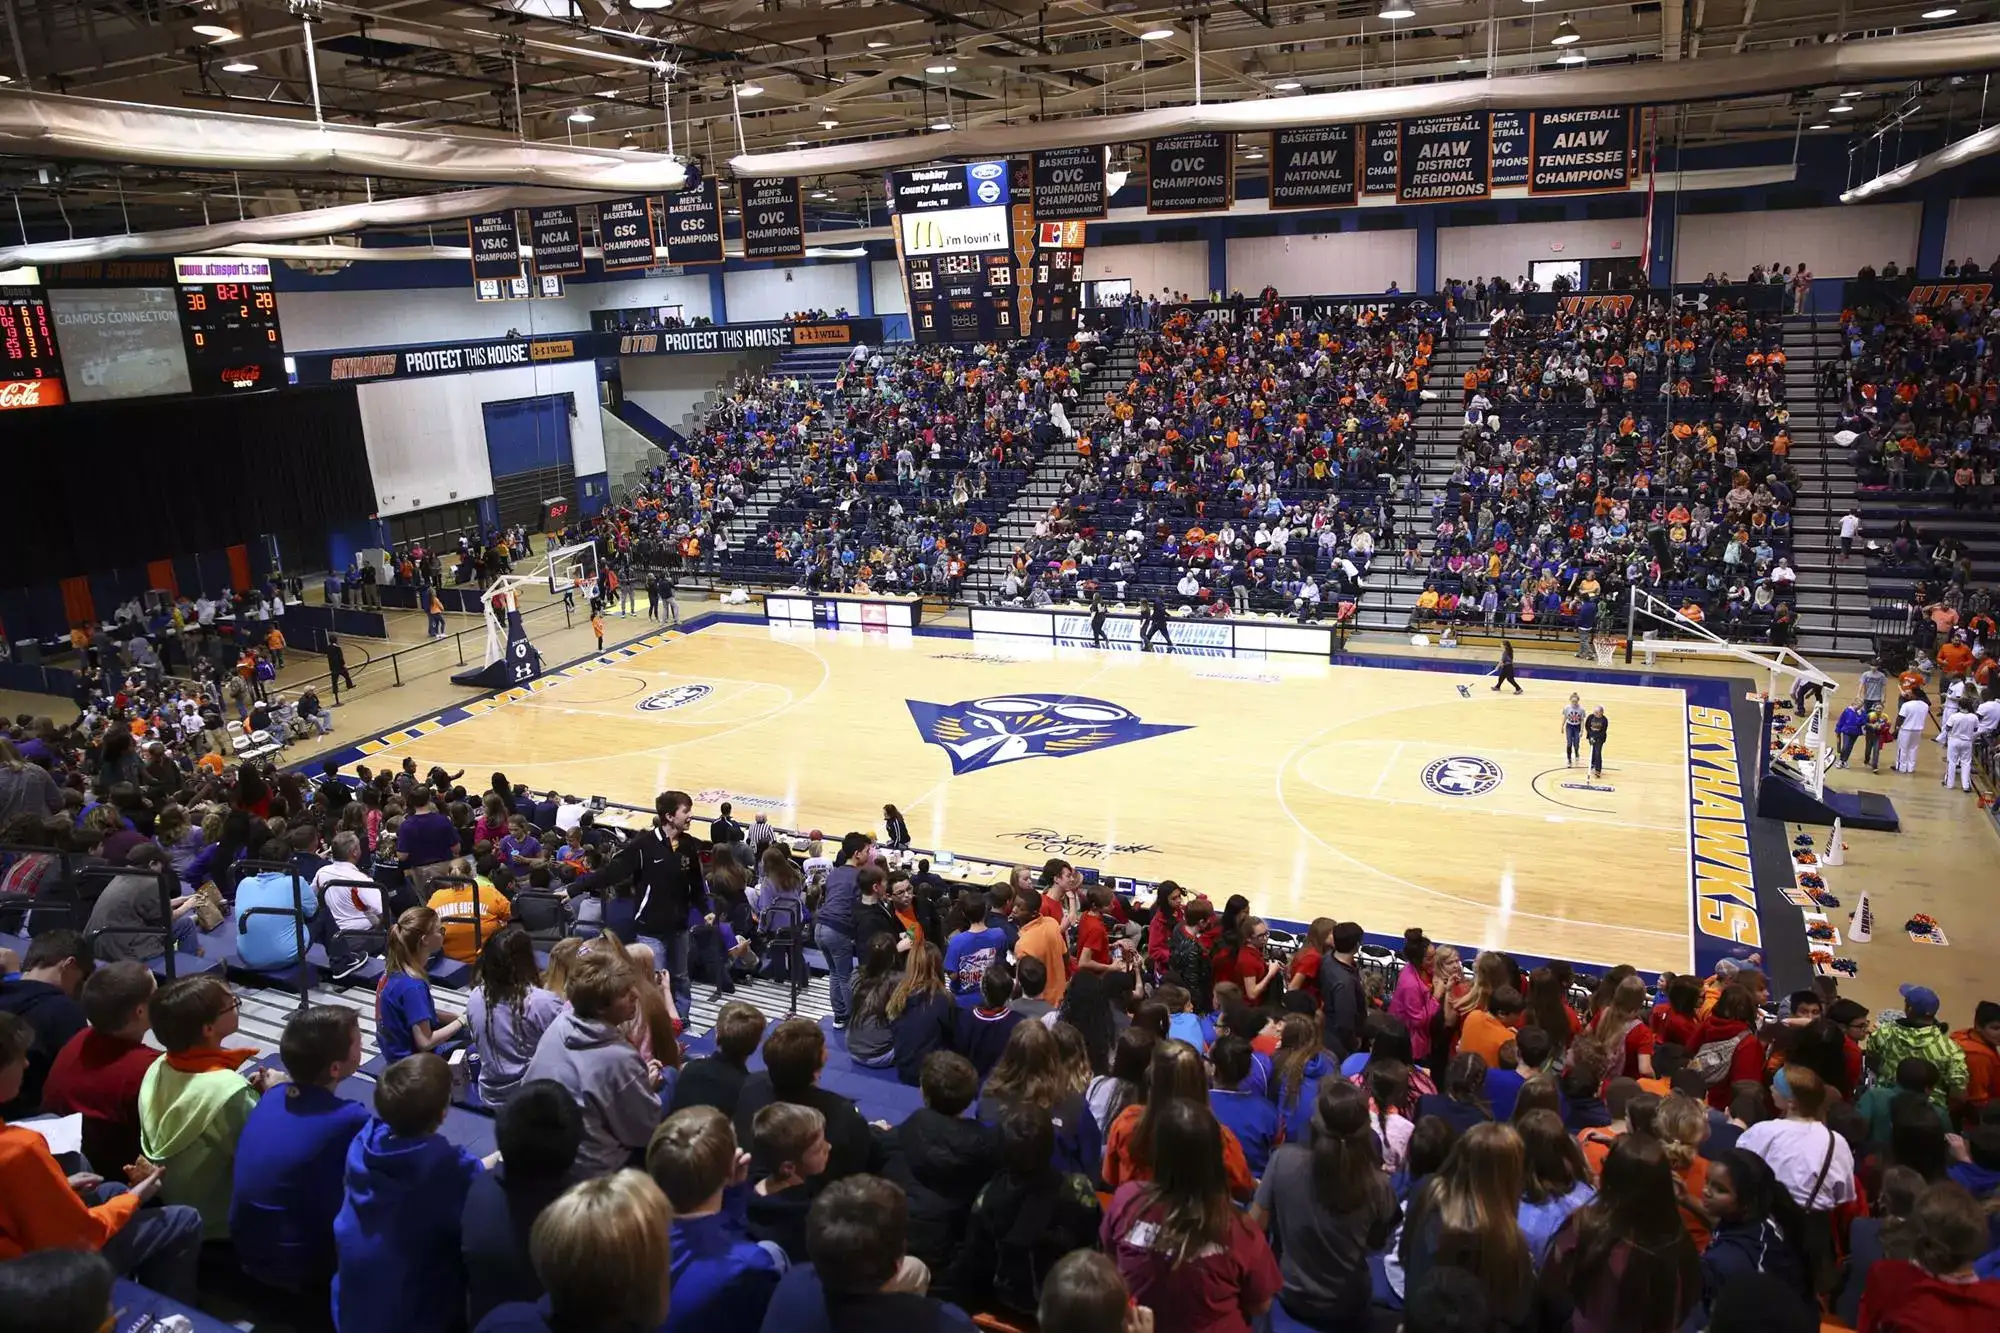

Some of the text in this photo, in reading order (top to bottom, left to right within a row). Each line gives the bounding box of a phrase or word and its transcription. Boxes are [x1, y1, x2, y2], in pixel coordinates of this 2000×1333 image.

[1542, 108, 1621, 125] BASKETBALL
[1408, 120, 1481, 136] BASKETBALL
[1280, 130, 1348, 144] BASKETBALL
[1552, 129, 1610, 149] AIAW
[1156, 138, 1219, 151] BASKETBALL
[1418, 140, 1471, 158] AIAW
[1039, 155, 1097, 168] BASKETBALL
[1289, 150, 1338, 167] AIAW
[1416, 157, 1473, 171] DISTRICT
[1539, 150, 1623, 167] TENNESSEE
[1170, 157, 1206, 173] OVC
[912, 170, 948, 181] Weakley
[1052, 168, 1084, 184] OVC
[1284, 169, 1342, 182] NATIONAL
[1412, 171, 1475, 184] REGIONAL
[1535, 167, 1624, 185] CHAMPIONS
[1152, 175, 1224, 189] CHAMPIONS
[758, 188, 781, 198] MEN'S
[900, 185, 930, 195] County
[1035, 181, 1102, 196] TOURNAMENT
[1274, 183, 1353, 197] TOURNAMENT
[1403, 183, 1485, 198] CHAMPIONS
[679, 195, 702, 205] MEN'S
[747, 195, 793, 207] BASKETBALL
[1039, 193, 1099, 206] CHAMPIONS
[1165, 197, 1196, 206] SECOND
[1197, 196, 1225, 205] ROUND
[612, 202, 633, 212] MEN'S
[669, 202, 713, 214] BASKETBALL
[1036, 205, 1103, 217] NCAA TOURNAMENT
[542, 210, 563, 219] MEN'S
[603, 209, 643, 220] BASKETBALL
[759, 211, 785, 225] OVC
[482, 217, 502, 225] MEN'S
[534, 217, 573, 227] BASKETBALL
[681, 218, 705, 231] GSC
[474, 224, 512, 233] BASKETBALL
[614, 224, 637, 237] GSC
[746, 226, 800, 240] CHAMPIONS
[541, 231, 570, 244] NCAA
[669, 233, 719, 245] CHAMPIONS
[946, 232, 1000, 245] i'm lovin' it
[481, 238, 508, 250] VSAC
[535, 244, 579, 255] TOURNAMENT
[603, 238, 651, 251] CHAMPIONS
[759, 246, 777, 254] FIRST
[777, 244, 801, 252] ROUND
[475, 252, 517, 262] CHAMPIONS
[619, 255, 653, 263] TOURNAMENT
[562, 261, 579, 269] FINALS
[911, 259, 929, 269] UTM
[989, 266, 1011, 286] 28
[483, 281, 495, 290] 23
[515, 280, 526, 289] 43
[546, 279, 556, 288] 13
[216, 284, 249, 300] 8:21
[950, 287, 972, 297] period
[187, 294, 206, 310] 38
[256, 292, 273, 308] 28
[21, 306, 28, 316] 6
[36, 306, 44, 316] 0
[240, 305, 249, 317] 2
[1559, 295, 1635, 319] UTM
[23, 317, 31, 327] 0
[39, 316, 46, 326] 2
[57, 310, 178, 325] CAMPUS CONNECTION
[25, 327, 33, 337] 8
[41, 327, 49, 336] 0
[267, 329, 276, 341] 0
[28, 337, 36, 347] 3
[194, 333, 204, 346] 0
[619, 334, 658, 354] UTM
[665, 332, 718, 351] PROTECT
[720, 330, 744, 348] THIS
[30, 348, 38, 358] 2
[405, 349, 462, 372] PROTECT
[463, 348, 488, 367] THIS
[34, 368, 42, 377] 3
[331, 354, 397, 380] SKYHAWKS
[233, 380, 253, 388] zero
[550, 505, 568, 517] 8:21
[1688, 704, 1762, 949] SKYHAWKS
